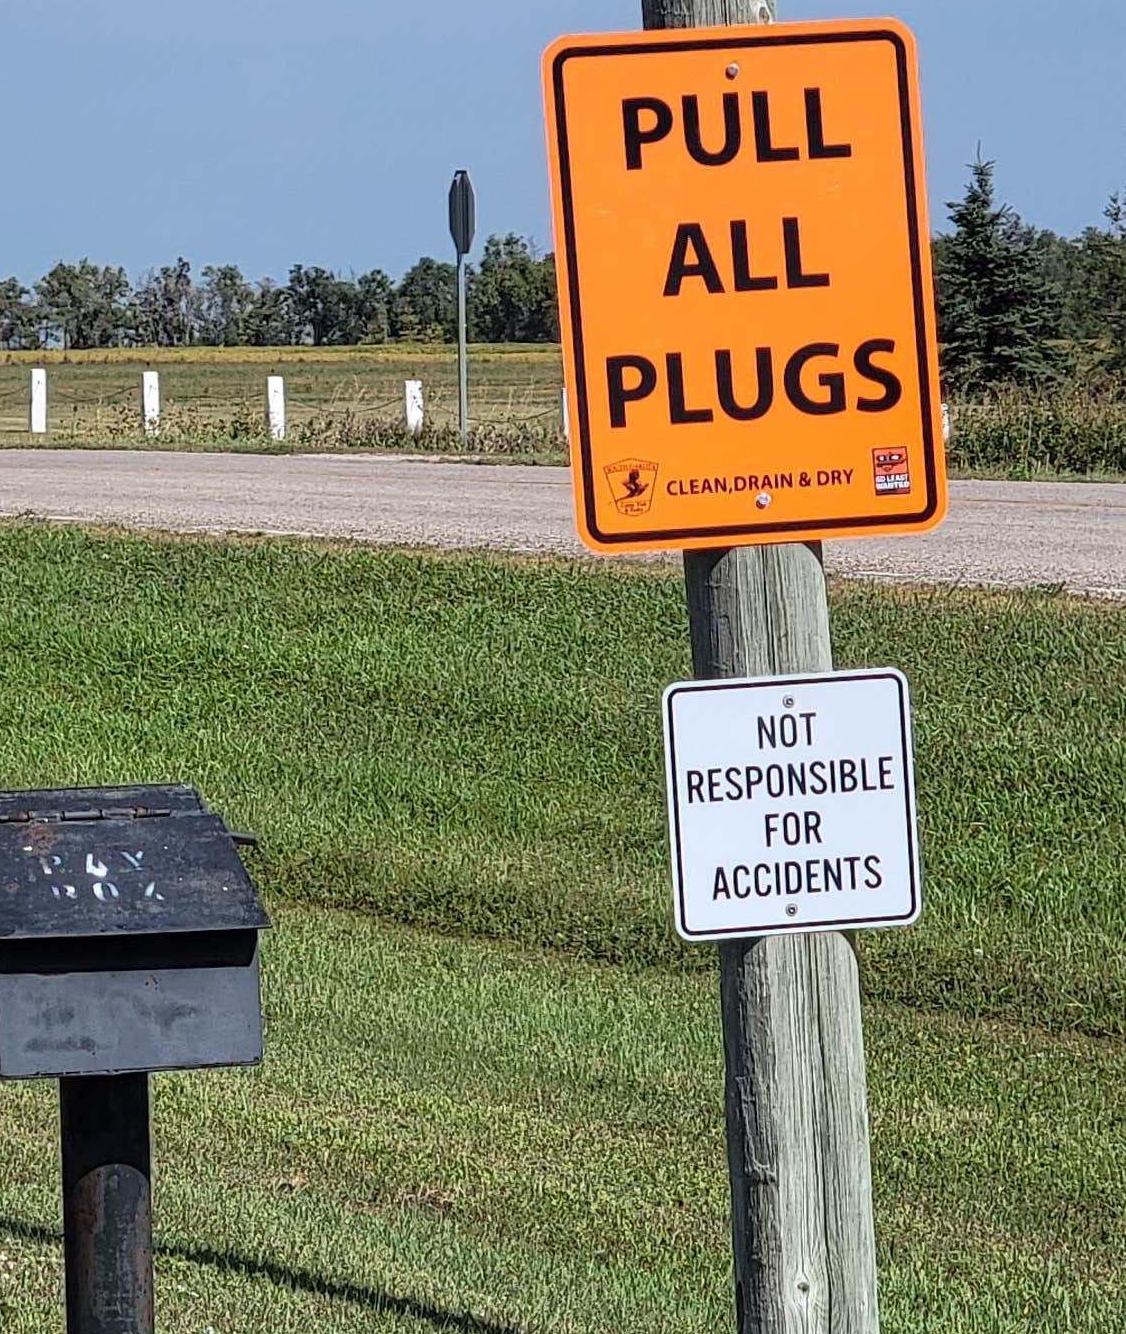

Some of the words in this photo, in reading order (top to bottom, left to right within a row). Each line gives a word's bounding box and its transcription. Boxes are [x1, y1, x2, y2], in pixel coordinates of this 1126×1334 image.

[622, 88, 851, 170] PULL
[663, 217, 830, 296] ALL
[606, 339, 901, 428] PLUGS
[799, 472, 811, 487] &
[817, 469, 853, 485] DRY
[758, 713, 816, 749] NOT
[687, 757, 894, 803] RESPONSIBLE
[765, 811, 821, 847] FOR
[713, 856, 881, 900] ACCIDENTS
